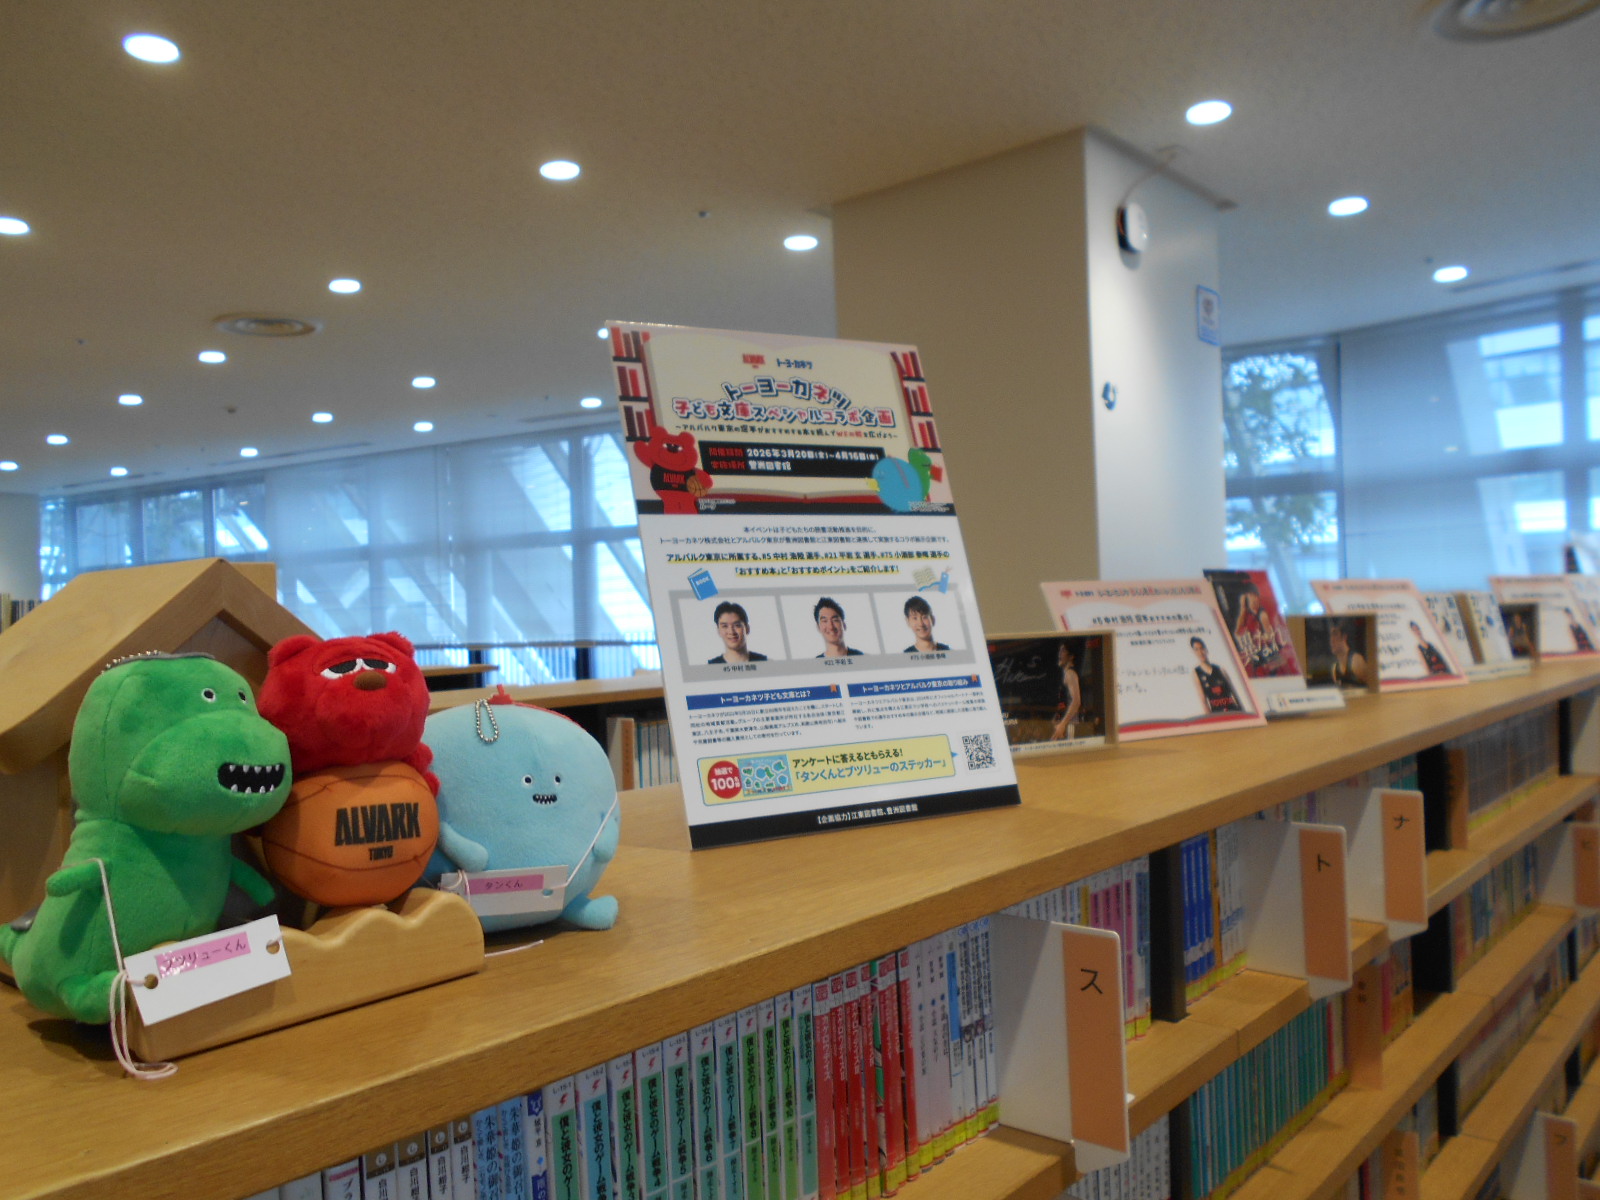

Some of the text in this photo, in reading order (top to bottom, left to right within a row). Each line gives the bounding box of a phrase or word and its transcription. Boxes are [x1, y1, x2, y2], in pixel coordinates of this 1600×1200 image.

[723, 377, 850, 408] トーヨーカネツ
[674, 398, 896, 427] 子ども文庫スペシャルコラボ企画
[749, 460, 792, 471] 豊洲図書館
[793, 748, 904, 769] アンケートに答えるともらえる!
[714, 767, 733, 777] 抽選で
[335, 802, 421, 847] ALVARK
[1393, 814, 1410, 829] ナ
[369, 846, 394, 861] TOKYO
[1317, 853, 1331, 872] ト
[485, 880, 523, 890] タンくん
[1080, 968, 1103, 995] ス
